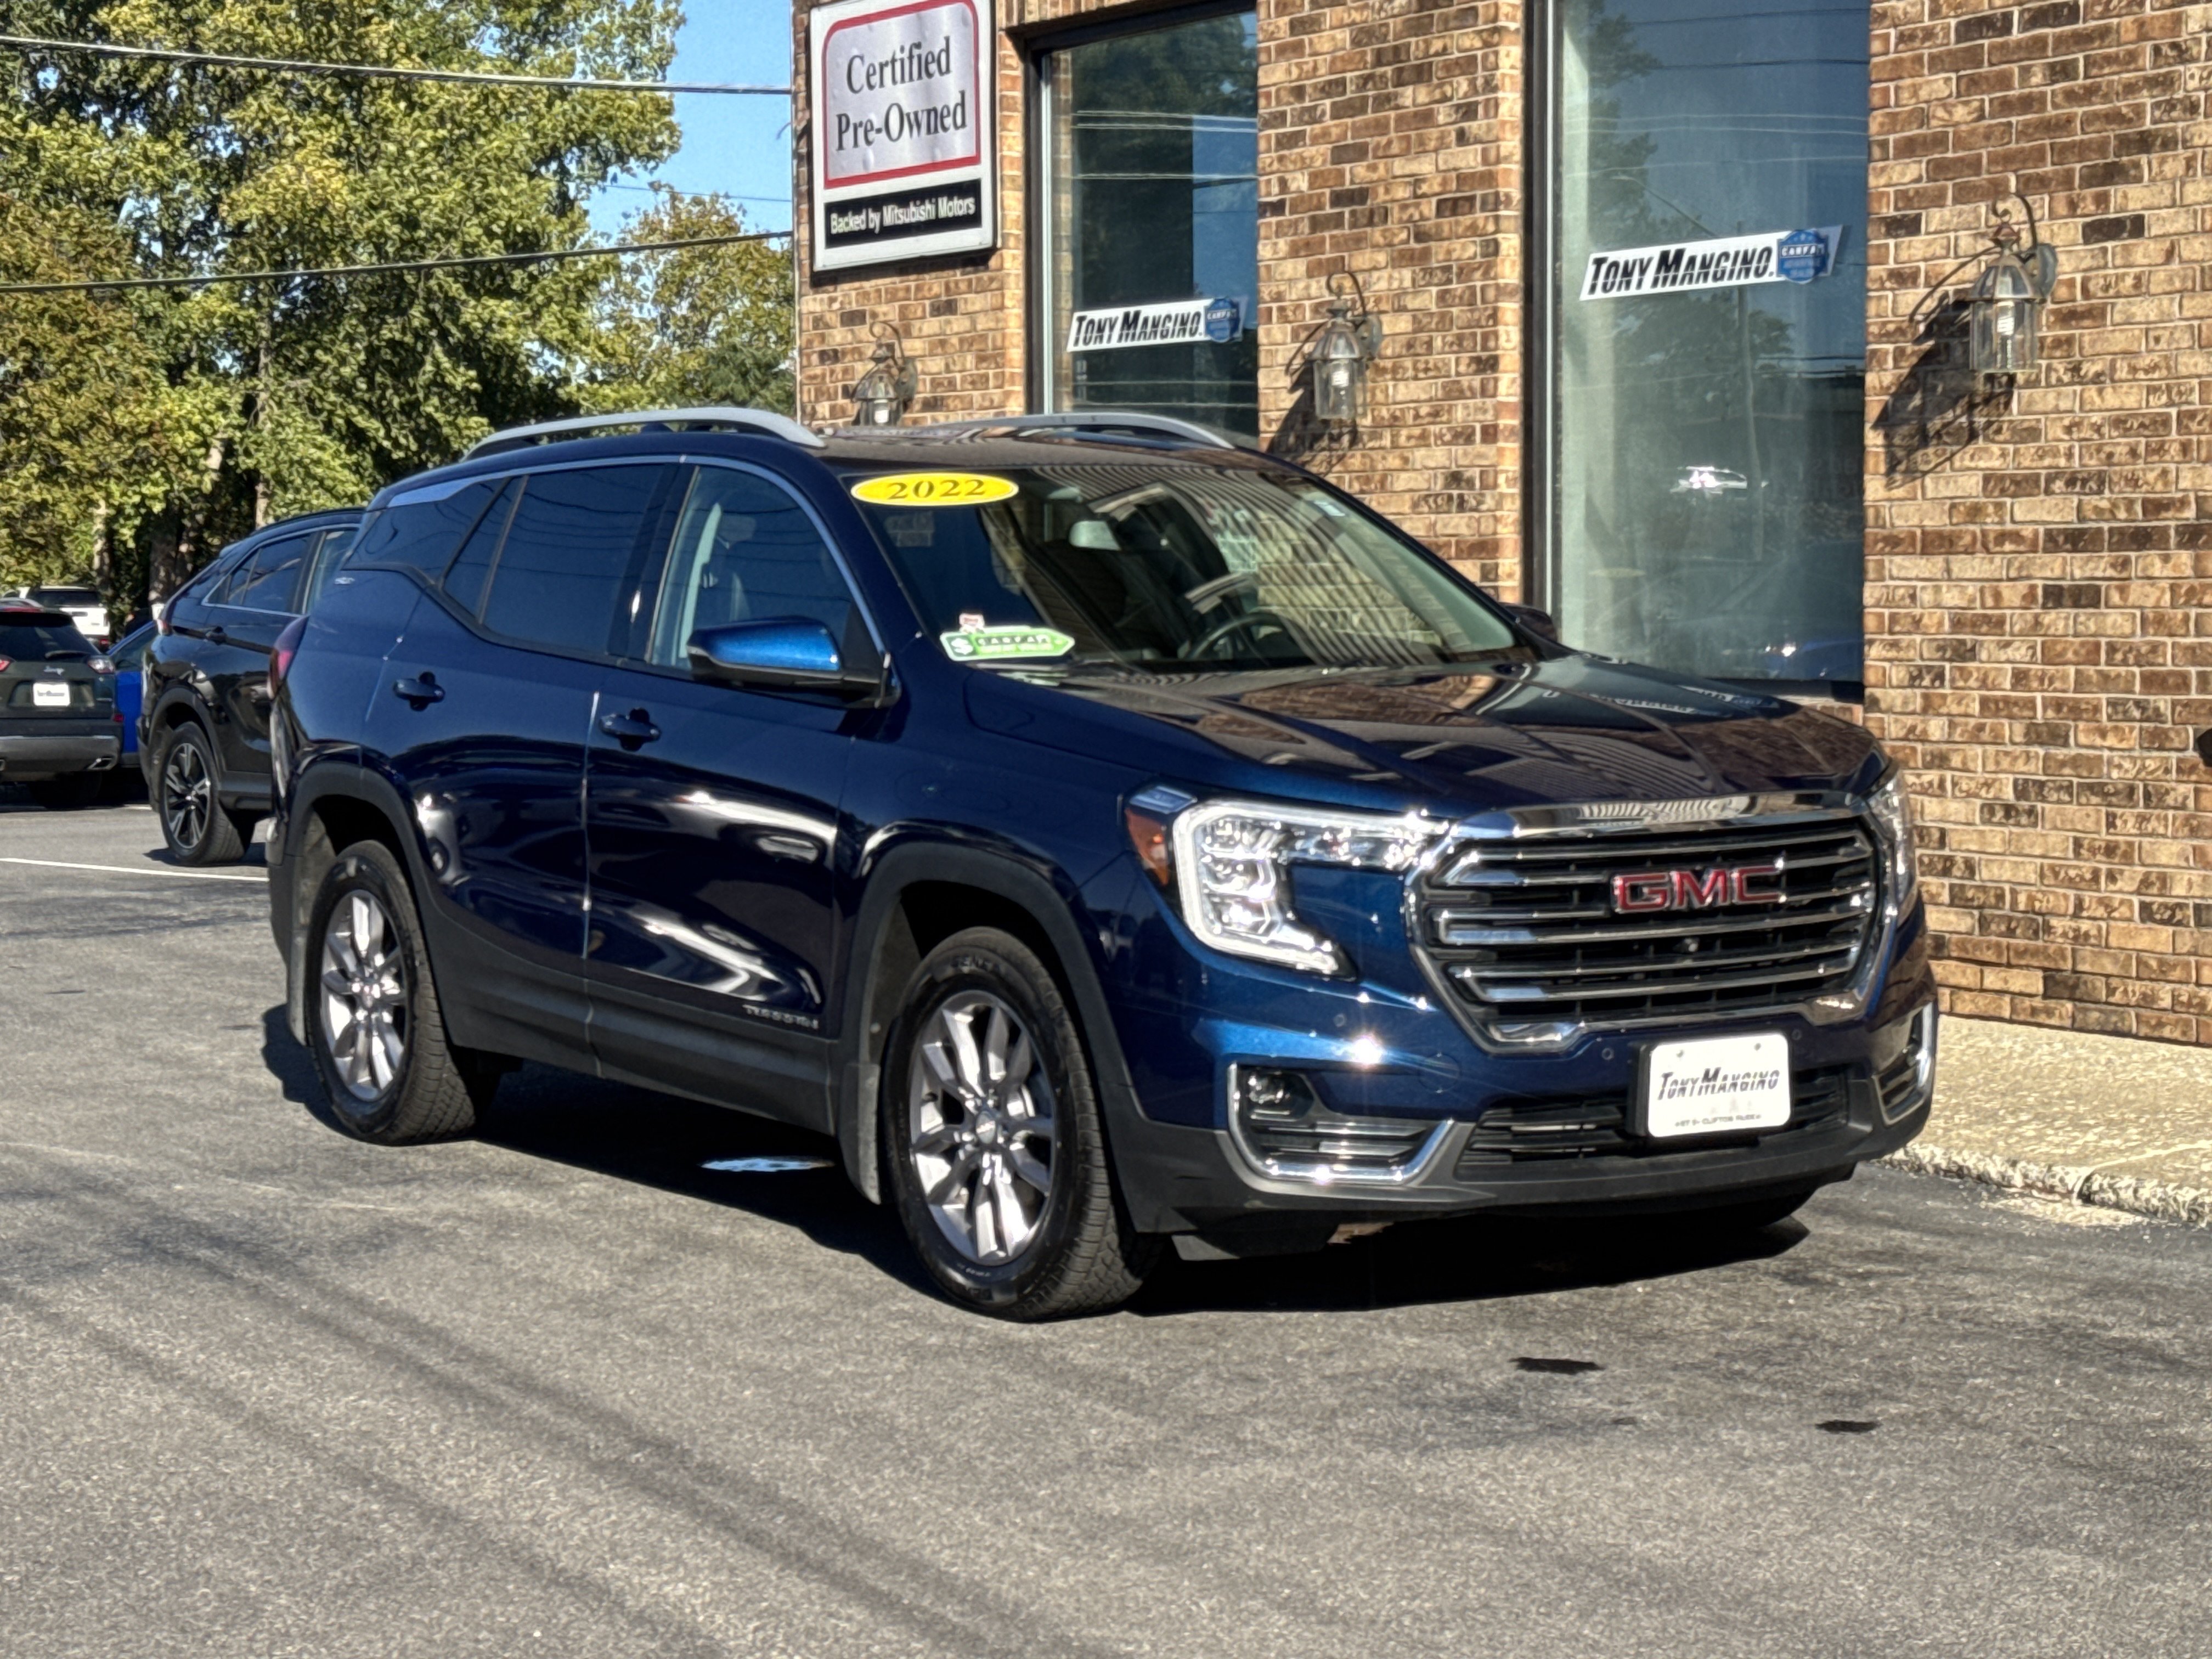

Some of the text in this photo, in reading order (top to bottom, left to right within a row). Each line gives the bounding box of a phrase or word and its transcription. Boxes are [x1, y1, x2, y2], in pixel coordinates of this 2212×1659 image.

[847, 36, 951, 94] Certified
[836, 89, 967, 151] Pre-Owned
[830, 196, 976, 234] Backed by Mitsubishi Motors
[1587, 256, 1655, 296] TONY
[1073, 315, 1119, 347] TONY
[887, 479, 986, 500] 2022
[1612, 861, 1786, 913] GMC
[1657, 1067, 1780, 1101] TONY MANGINO
